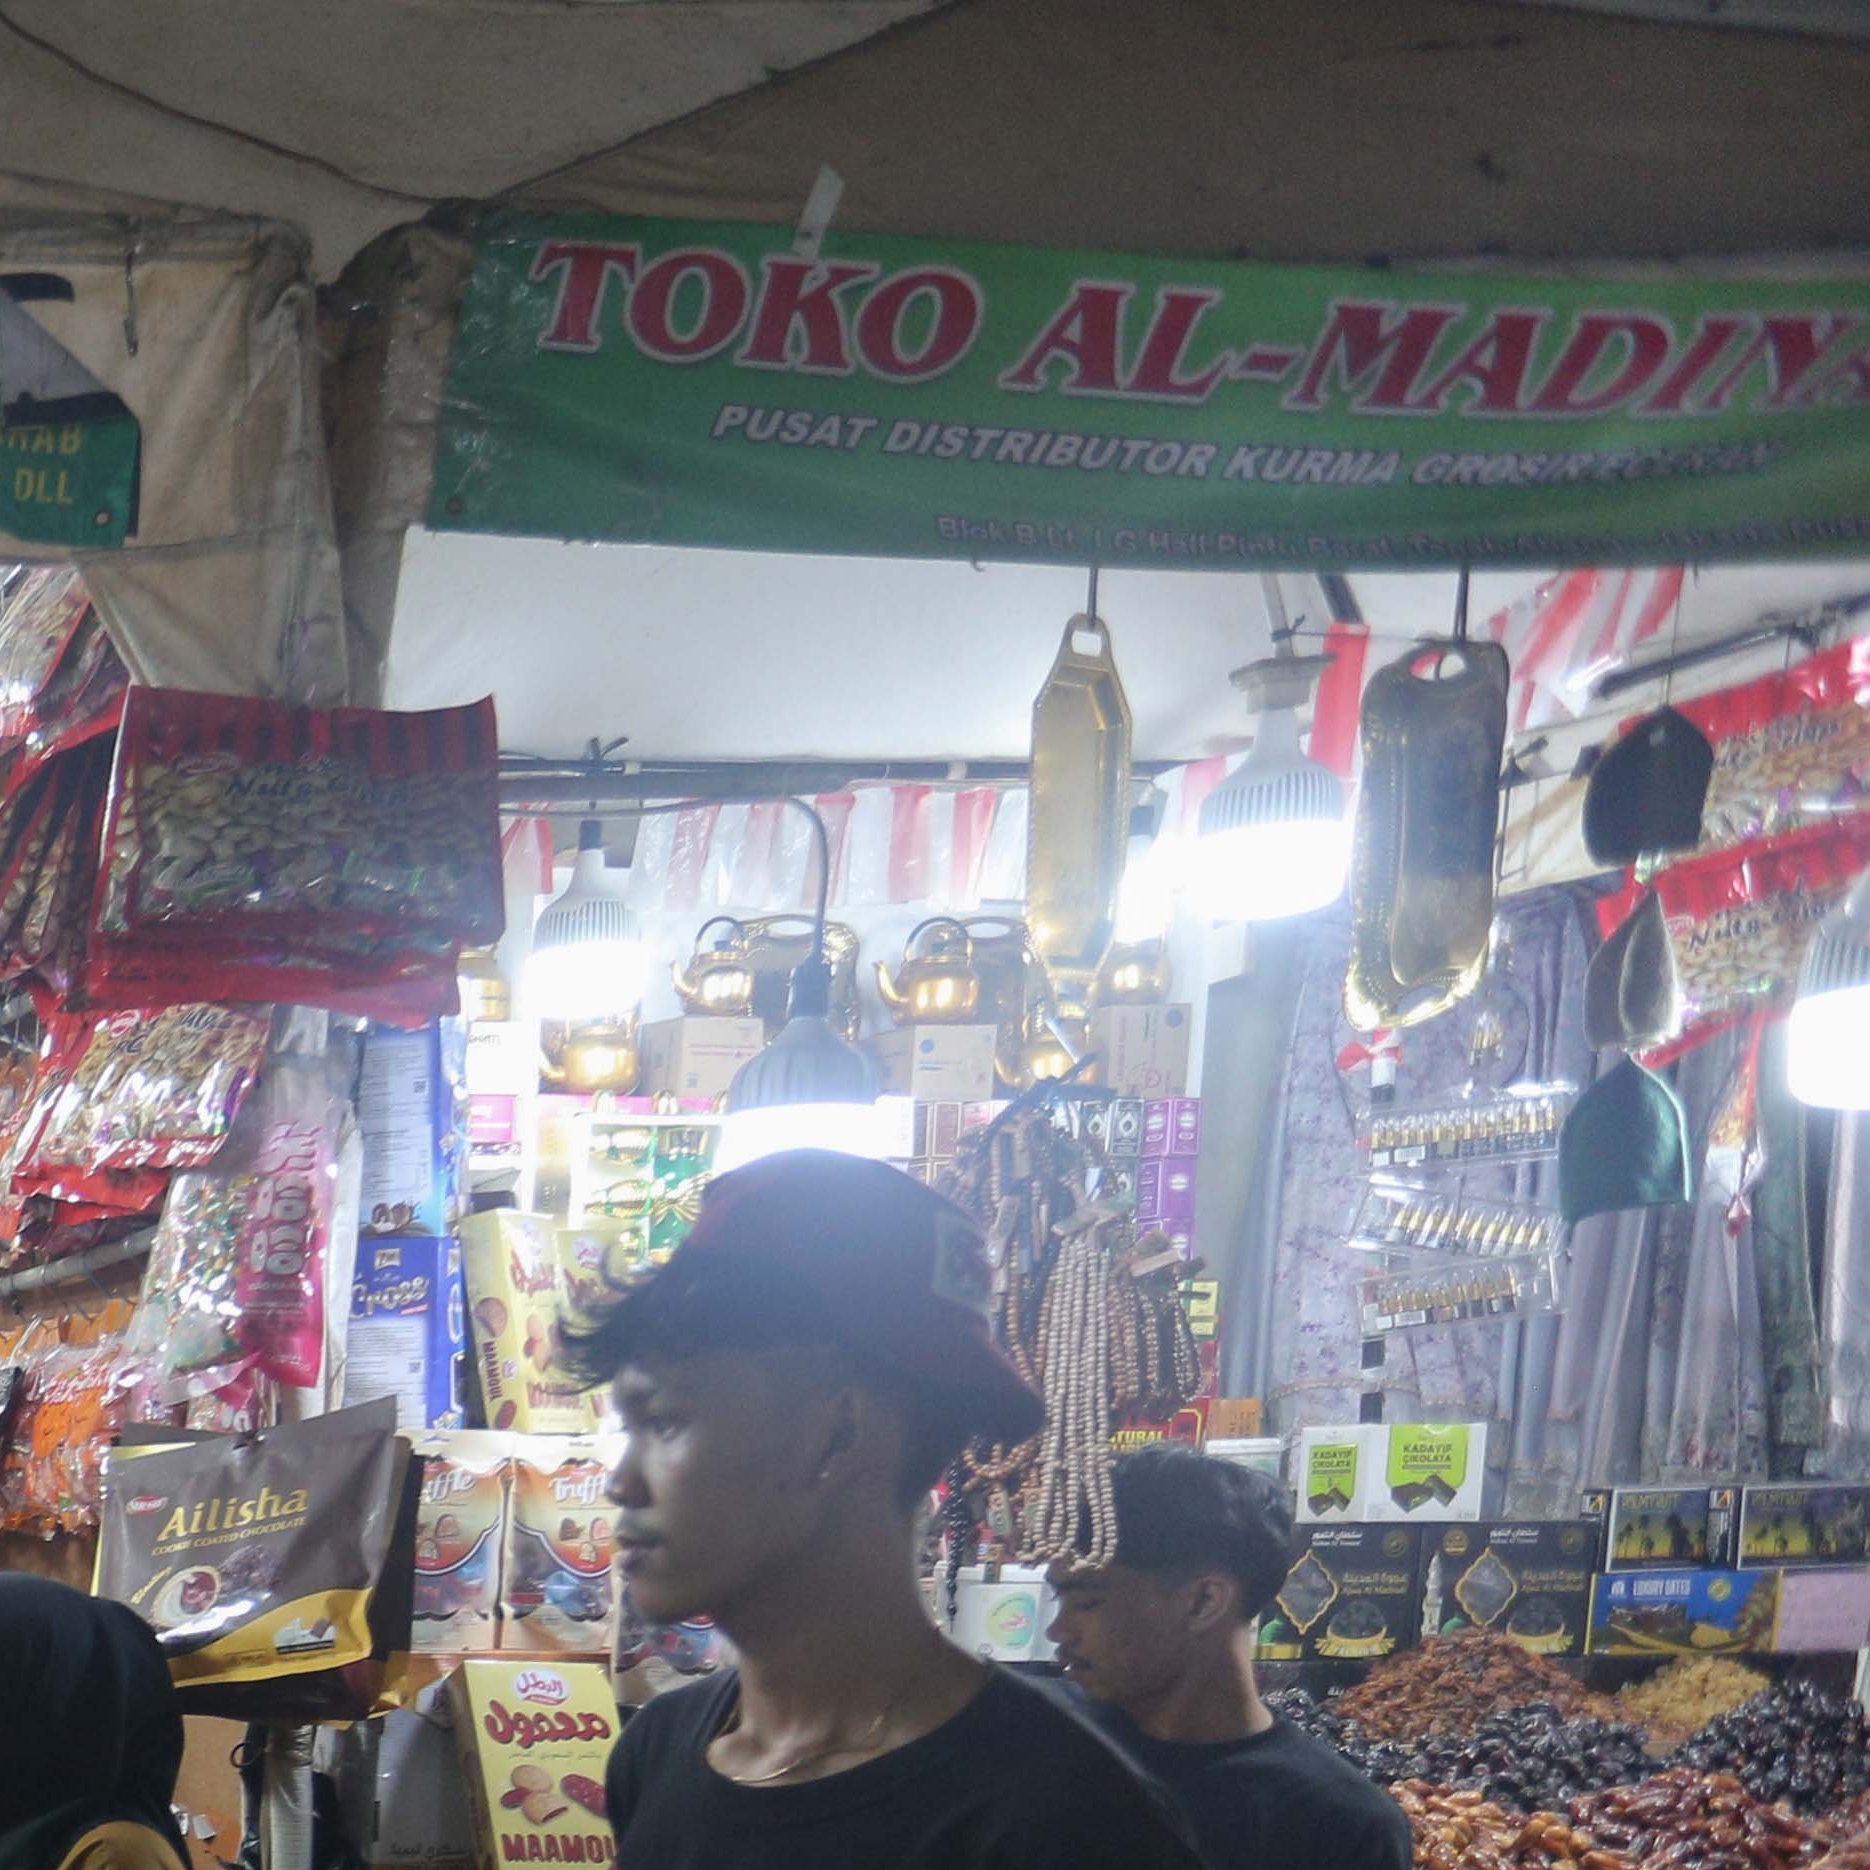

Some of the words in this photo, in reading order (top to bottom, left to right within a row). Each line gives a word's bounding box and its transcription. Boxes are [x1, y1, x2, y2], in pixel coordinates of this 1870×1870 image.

[528, 238, 983, 384] TOKO
[711, 402, 881, 453] PUSAT
[883, 414, 1217, 480] DISTRIBUTOR
[1222, 442, 1402, 487] KURMA
[13, 467, 79, 505] DLL
[1401, 1442, 1453, 1455] KADAYIF
[156, 1485, 311, 1542] Ailisha
